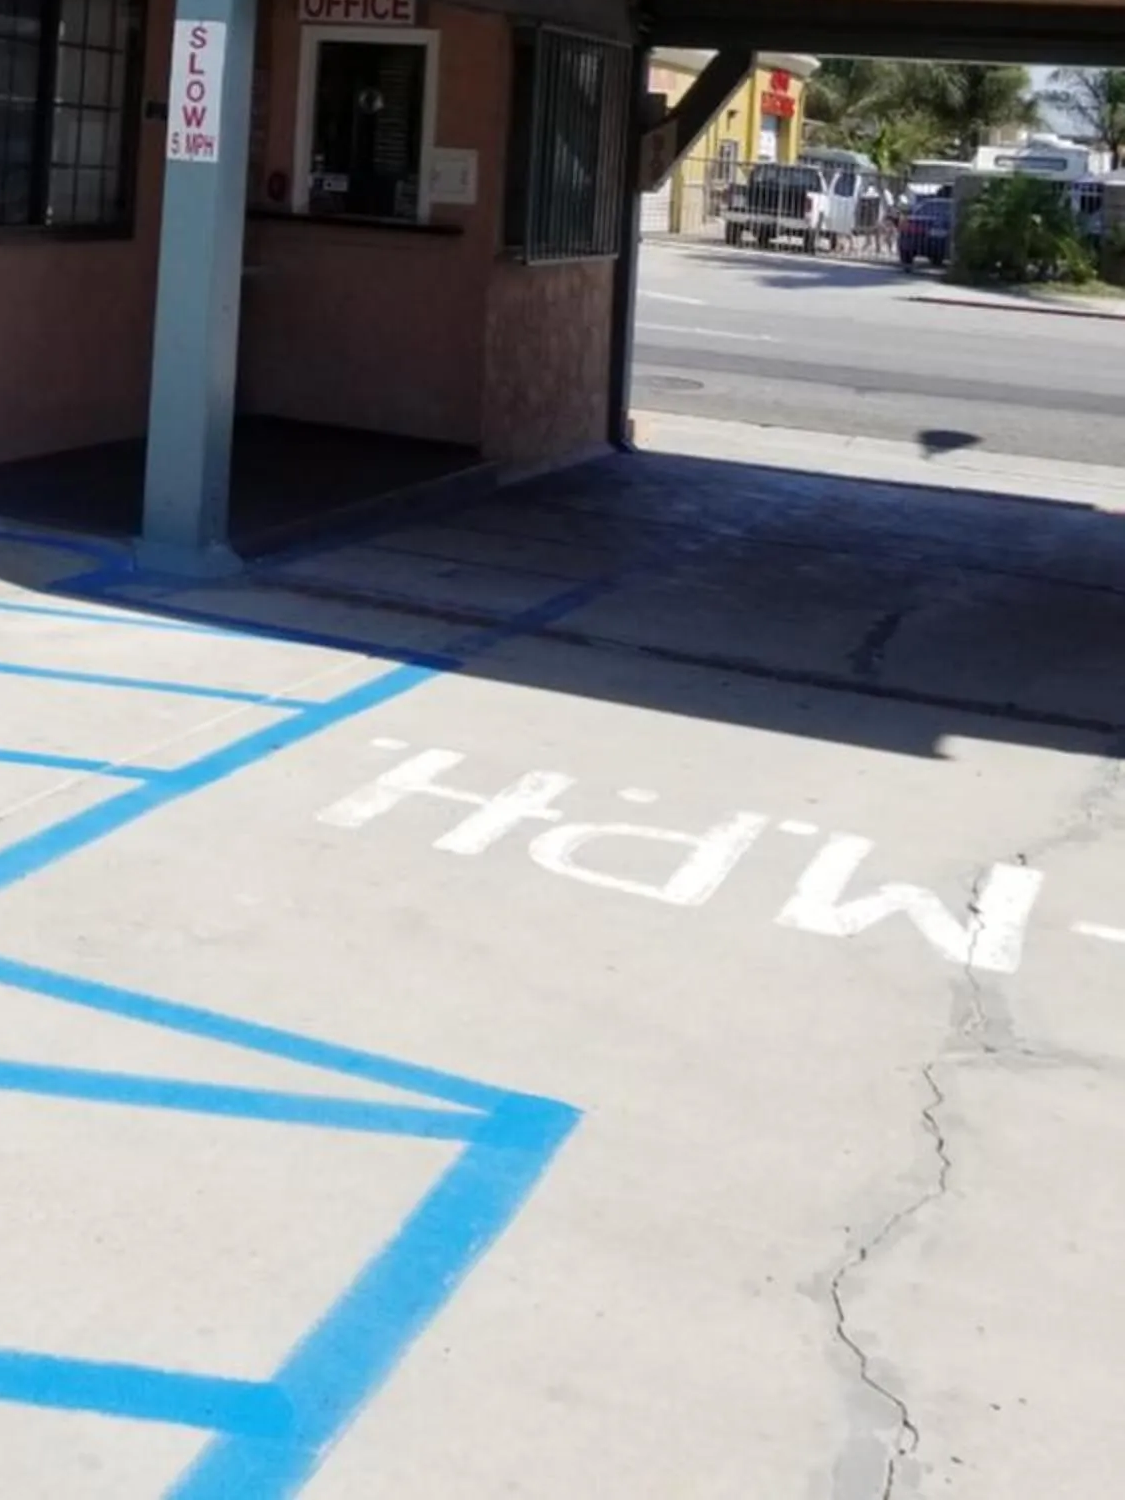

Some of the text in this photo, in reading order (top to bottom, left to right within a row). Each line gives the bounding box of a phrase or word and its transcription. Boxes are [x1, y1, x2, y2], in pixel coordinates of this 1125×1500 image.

[182, 26, 208, 129] SLOW
[171, 132, 215, 157] 5 MPH
